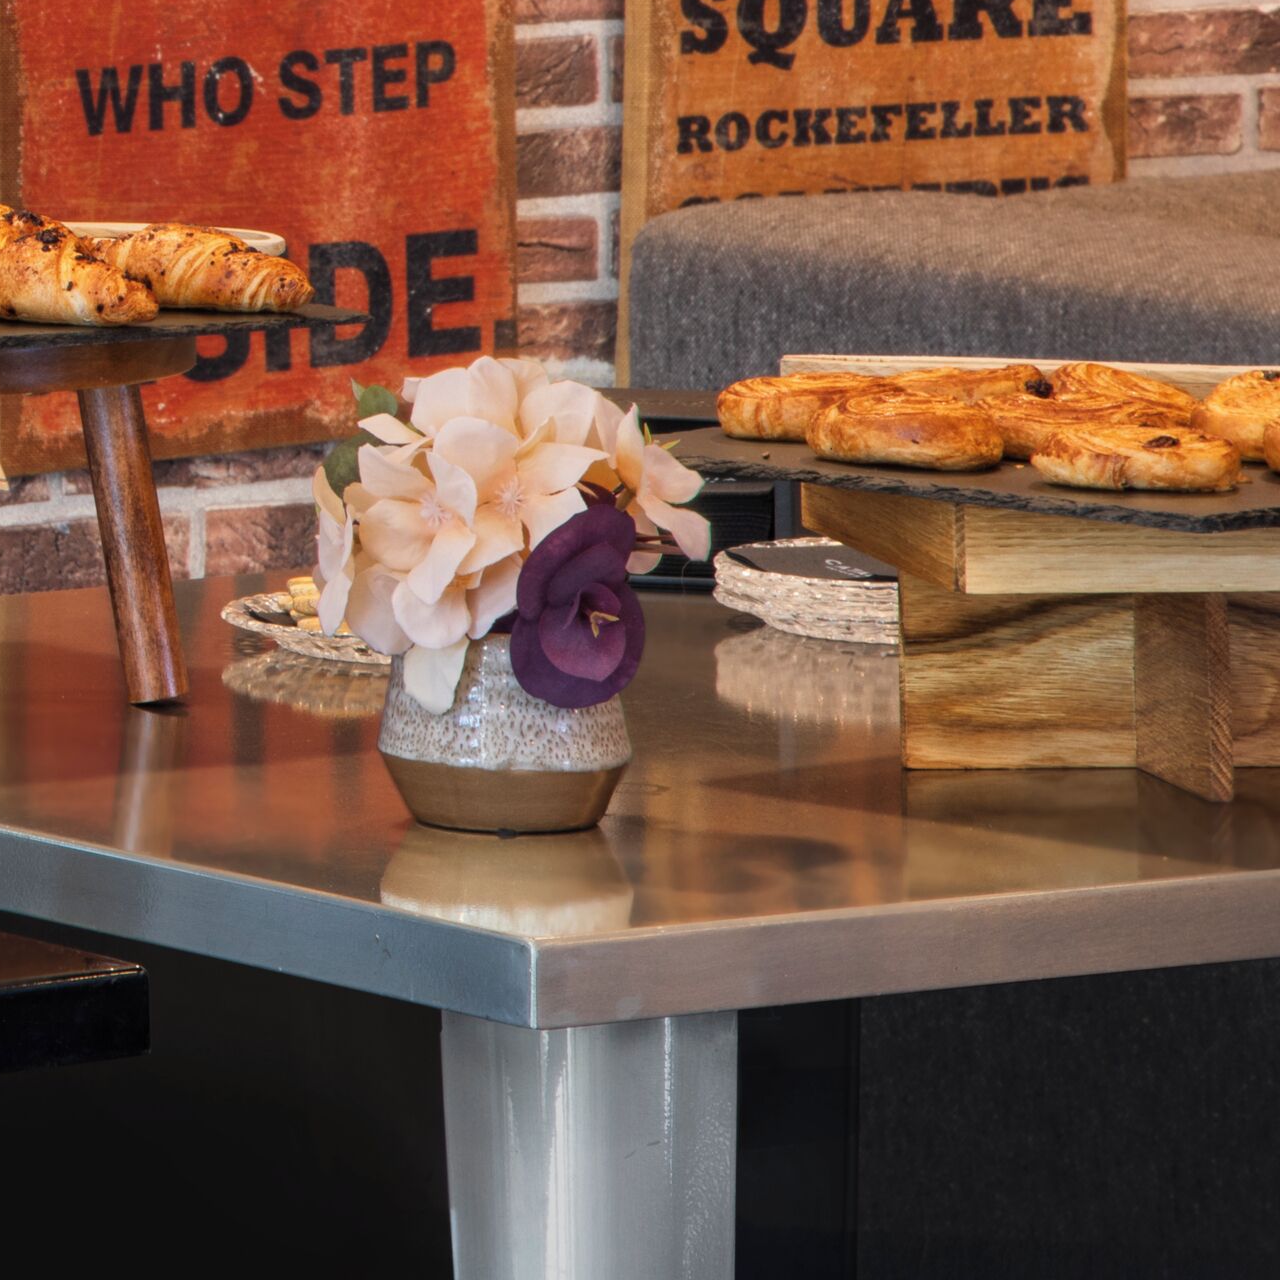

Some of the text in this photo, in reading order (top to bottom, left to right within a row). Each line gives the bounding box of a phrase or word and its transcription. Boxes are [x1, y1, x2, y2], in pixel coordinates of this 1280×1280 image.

[75, 39, 457, 137] WHO STEP
[676, 95, 1090, 154] ROCKEFELLER
